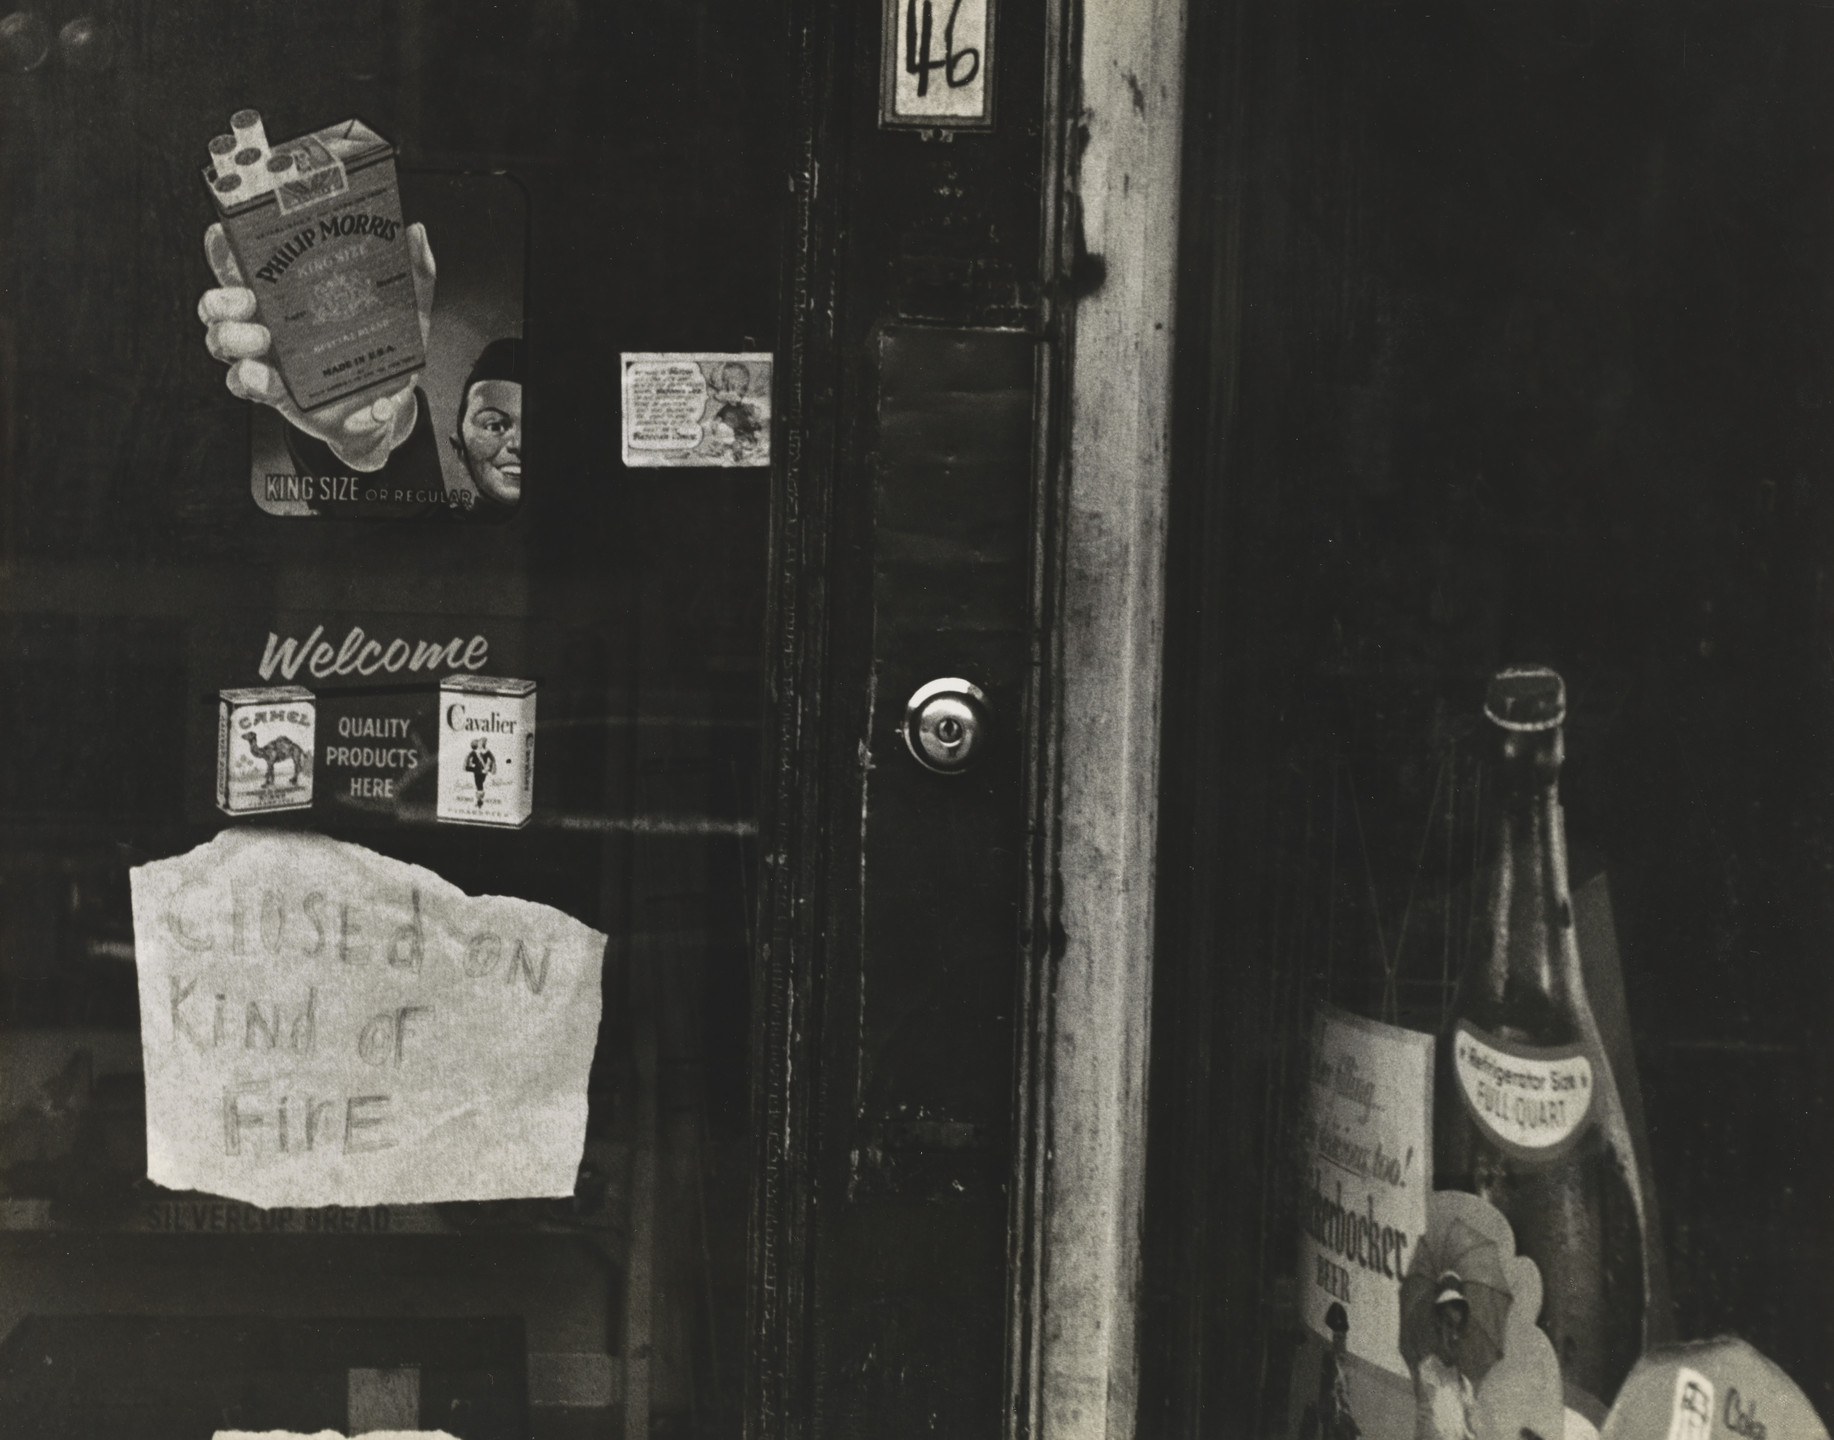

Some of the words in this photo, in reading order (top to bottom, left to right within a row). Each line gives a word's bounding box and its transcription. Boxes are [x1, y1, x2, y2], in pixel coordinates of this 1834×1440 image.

[906, 0, 980, 97] 46
[256, 228, 317, 285] PHILIP
[318, 213, 400, 243] MORRIS
[266, 476, 314, 500] KING
[319, 477, 360, 500] SIZE
[365, 489, 387, 501] OR
[395, 489, 473, 503] REGULAR
[258, 624, 489, 681] Welcome
[238, 709, 311, 731] CAMEL
[338, 717, 411, 739] QUALITY
[446, 703, 518, 736] Cavalier
[326, 746, 419, 769] PRODUCTS
[351, 778, 394, 799] HERE
[1477, 1079, 1509, 1121] FULL
[1516, 1096, 1567, 1129] QUART
